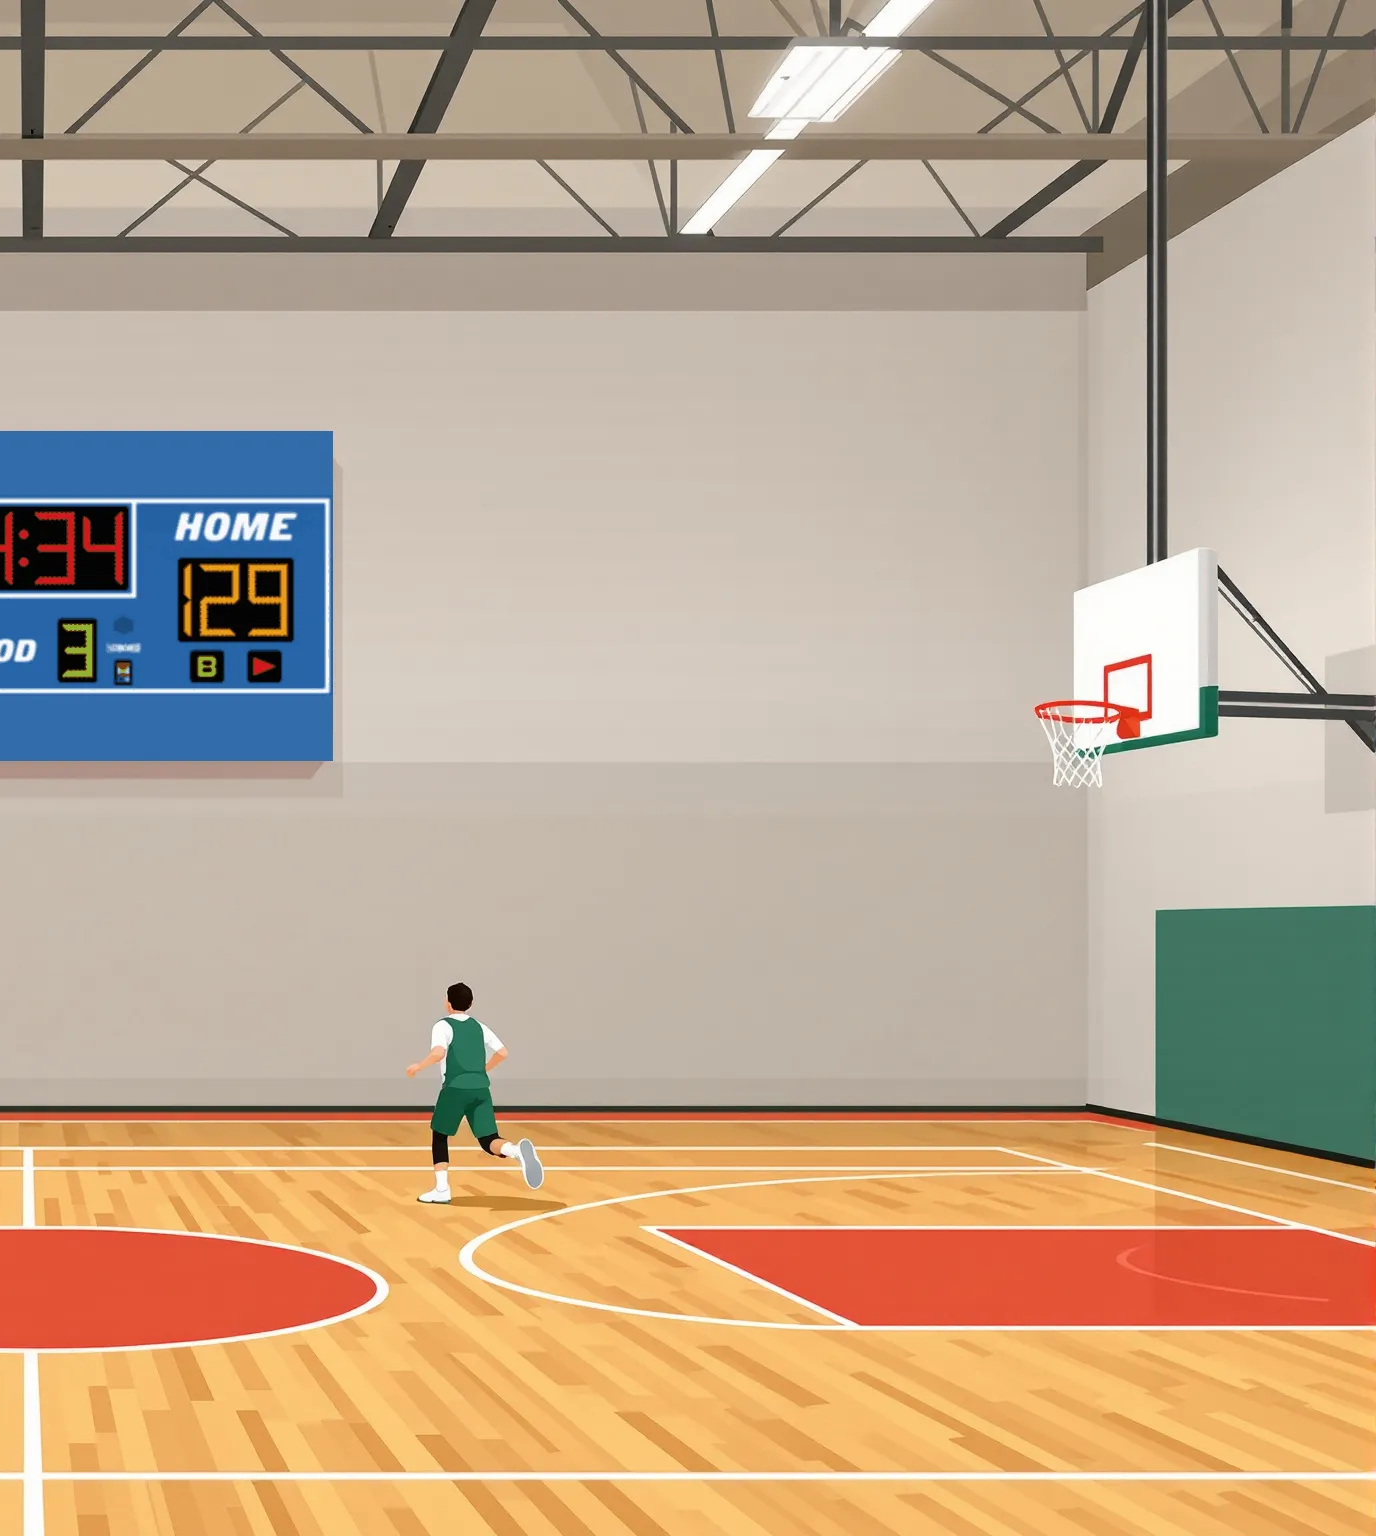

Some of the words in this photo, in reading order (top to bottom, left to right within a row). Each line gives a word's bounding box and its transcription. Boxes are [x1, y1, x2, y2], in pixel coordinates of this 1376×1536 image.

[174, 512, 298, 542] HOME
[183, 563, 289, 637] 129
[62, 623, 94, 678] 3
[197, 656, 217, 678] B
